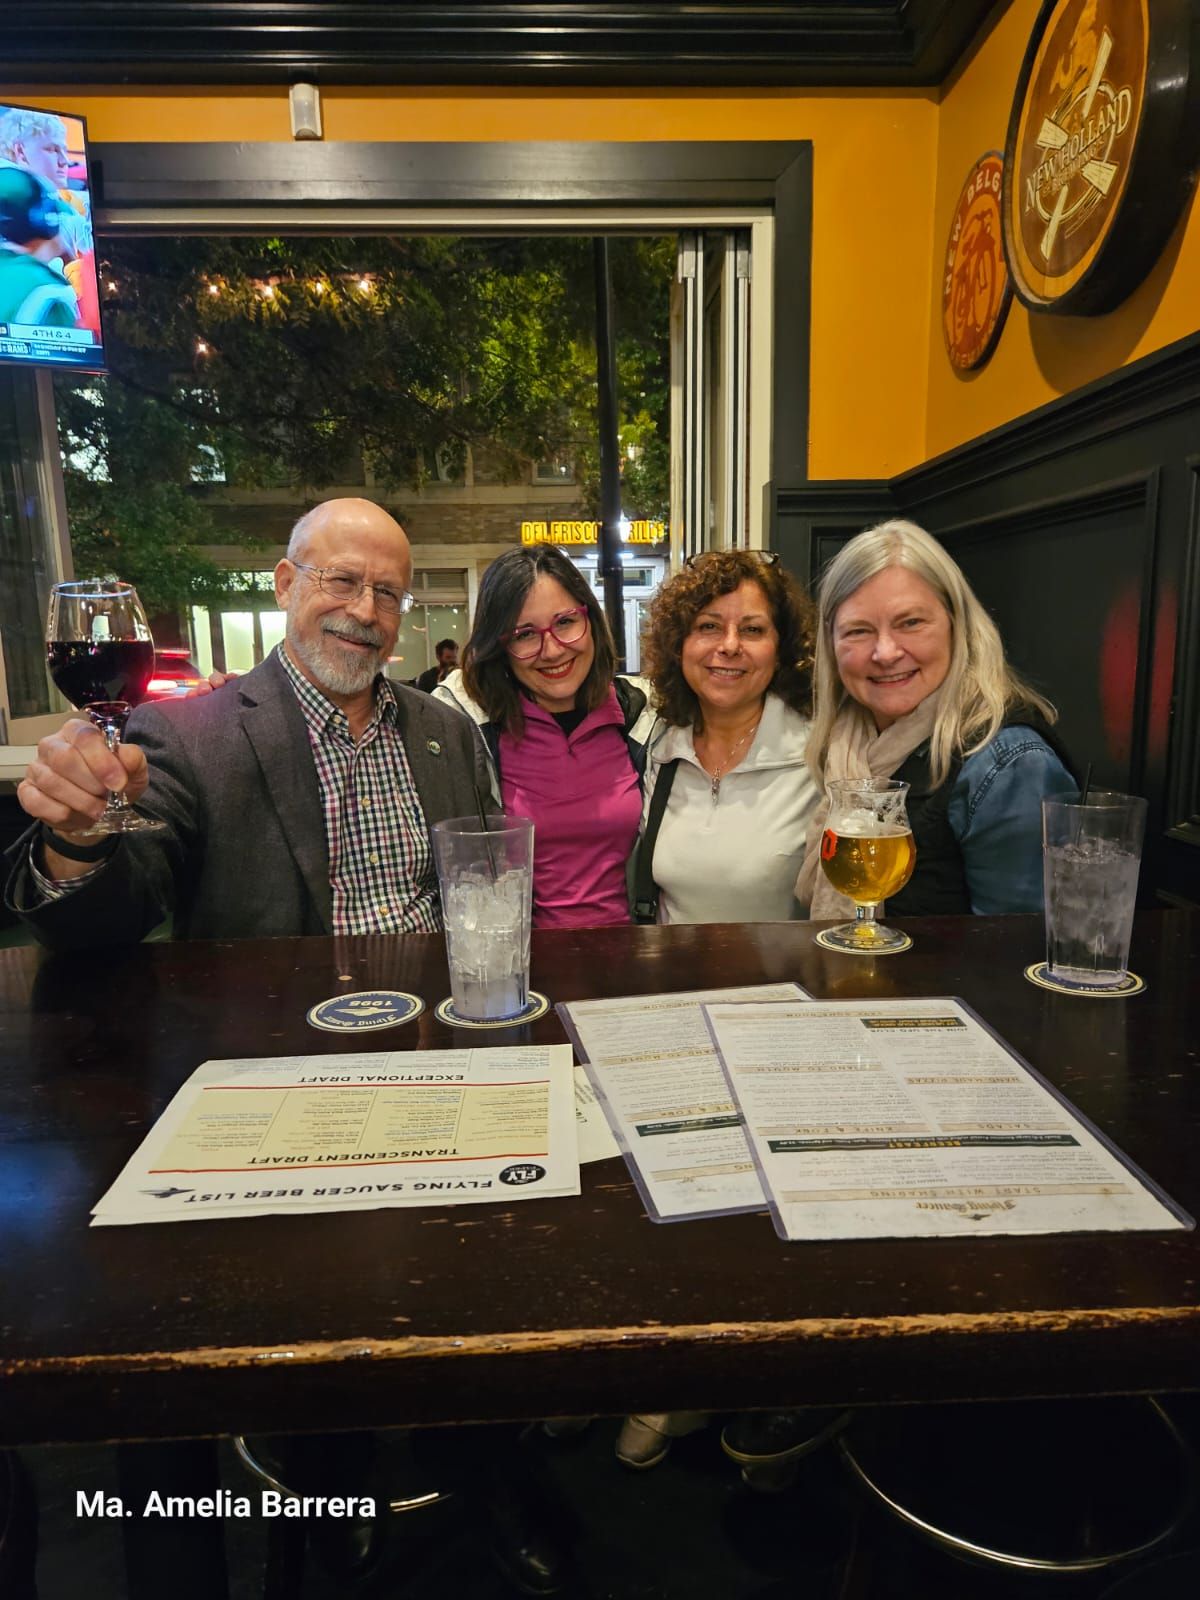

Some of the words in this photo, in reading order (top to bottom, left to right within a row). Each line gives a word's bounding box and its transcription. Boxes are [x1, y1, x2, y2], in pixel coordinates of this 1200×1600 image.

[1025, 155, 1058, 211] NEW
[1060, 88, 1131, 168] HOLLAND
[944, 216, 963, 296] NEW
[966, 167, 1004, 206] BELG
[32, 329, 54, 338] 4TH
[55, 331, 63, 339] &
[65, 332, 72, 340] 4
[521, 521, 548, 544] DEL
[550, 521, 600, 543] FRISCO
[622, 520, 665, 544] RILLE
[296, 1075, 351, 1085] DRAFT
[355, 1074, 465, 1084] EXCEPTIONAL
[247, 1154, 308, 1165] DRAFT
[312, 1148, 459, 1162] TRANSCENDENT
[507, 1170, 536, 1181] FLY
[311, 1184, 403, 1196] SAUCER
[413, 1181, 493, 1190] FLYING
[183, 1192, 235, 1203] LIST
[243, 1188, 303, 1199] BEER
[868, 1189, 938, 1197] SHARING
